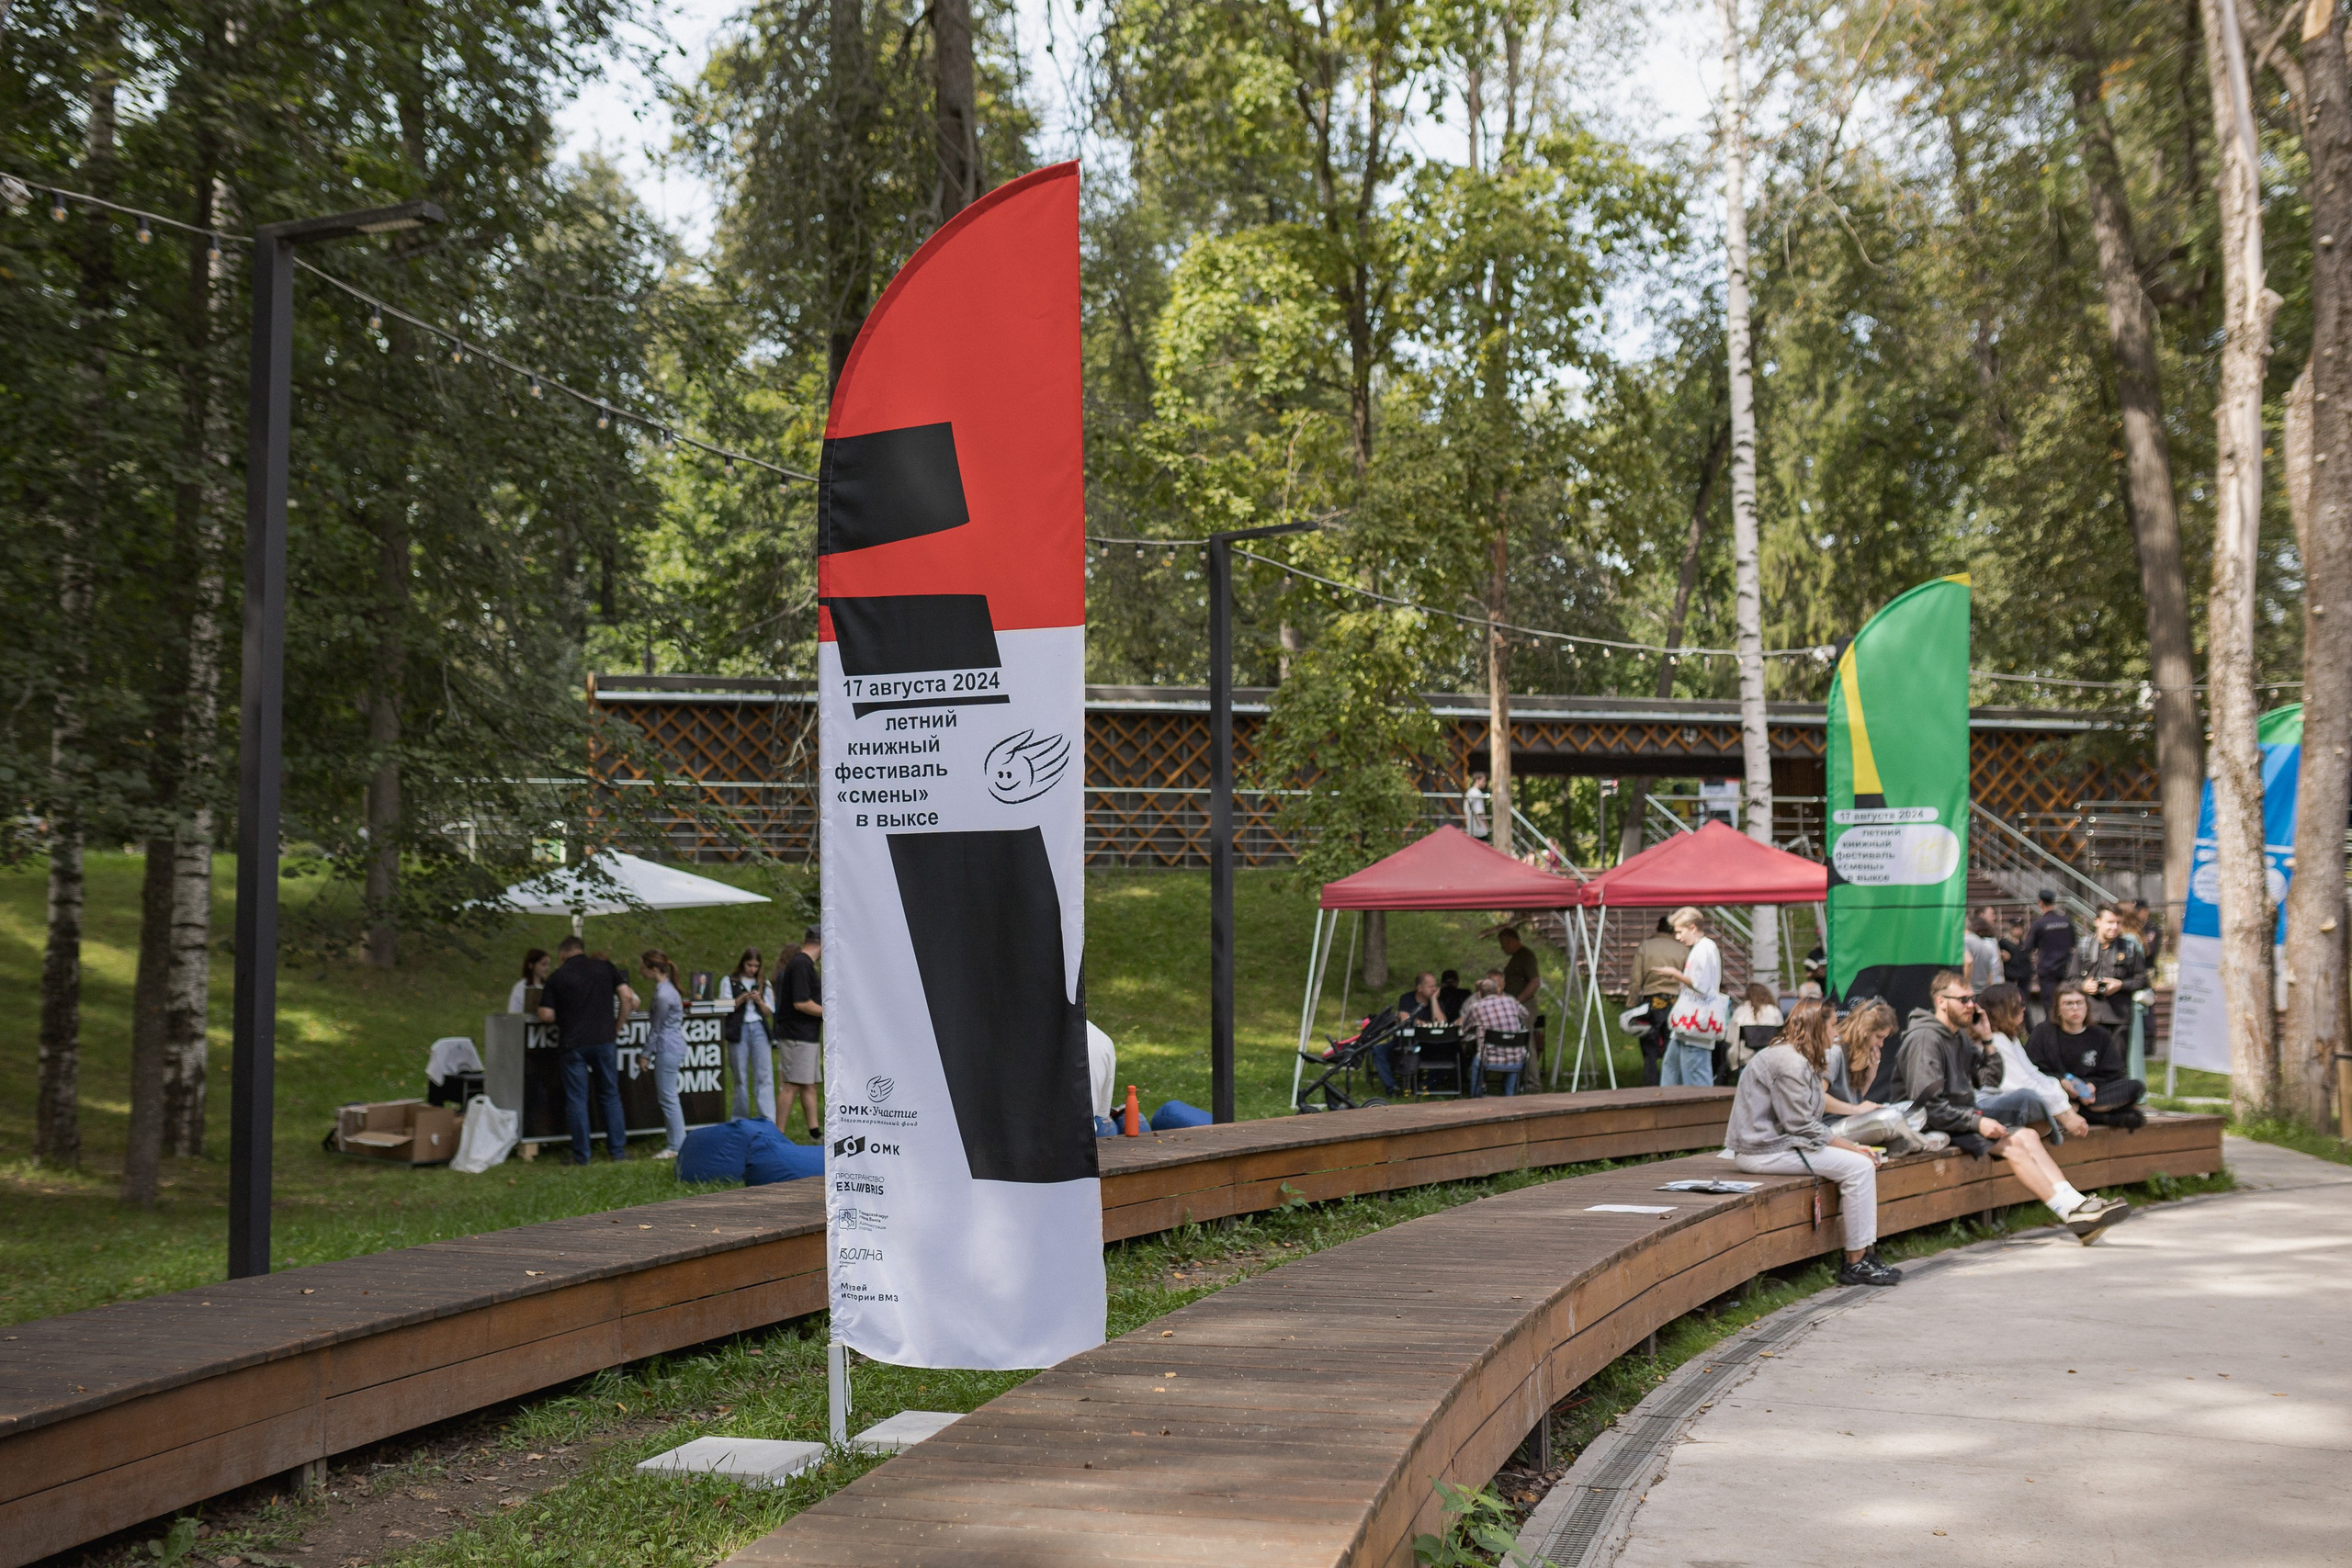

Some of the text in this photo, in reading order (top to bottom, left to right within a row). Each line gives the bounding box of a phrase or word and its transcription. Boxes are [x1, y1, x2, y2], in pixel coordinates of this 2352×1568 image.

[842, 671, 1001, 699] 17 августа 2024
[885, 709, 957, 731] летний
[847, 735, 941, 756] книжный
[834, 761, 948, 784] фестиваль
[836, 788, 929, 804] «смены»
[855, 812, 939, 828] в выксе
[1839, 810, 1924, 823] 17 августа 2024
[1862, 829, 1901, 837] летний
[1836, 852, 1895, 861] фестиваль
[870, 1143, 900, 1156] ОМК
[841, 1292, 876, 1302] истории
